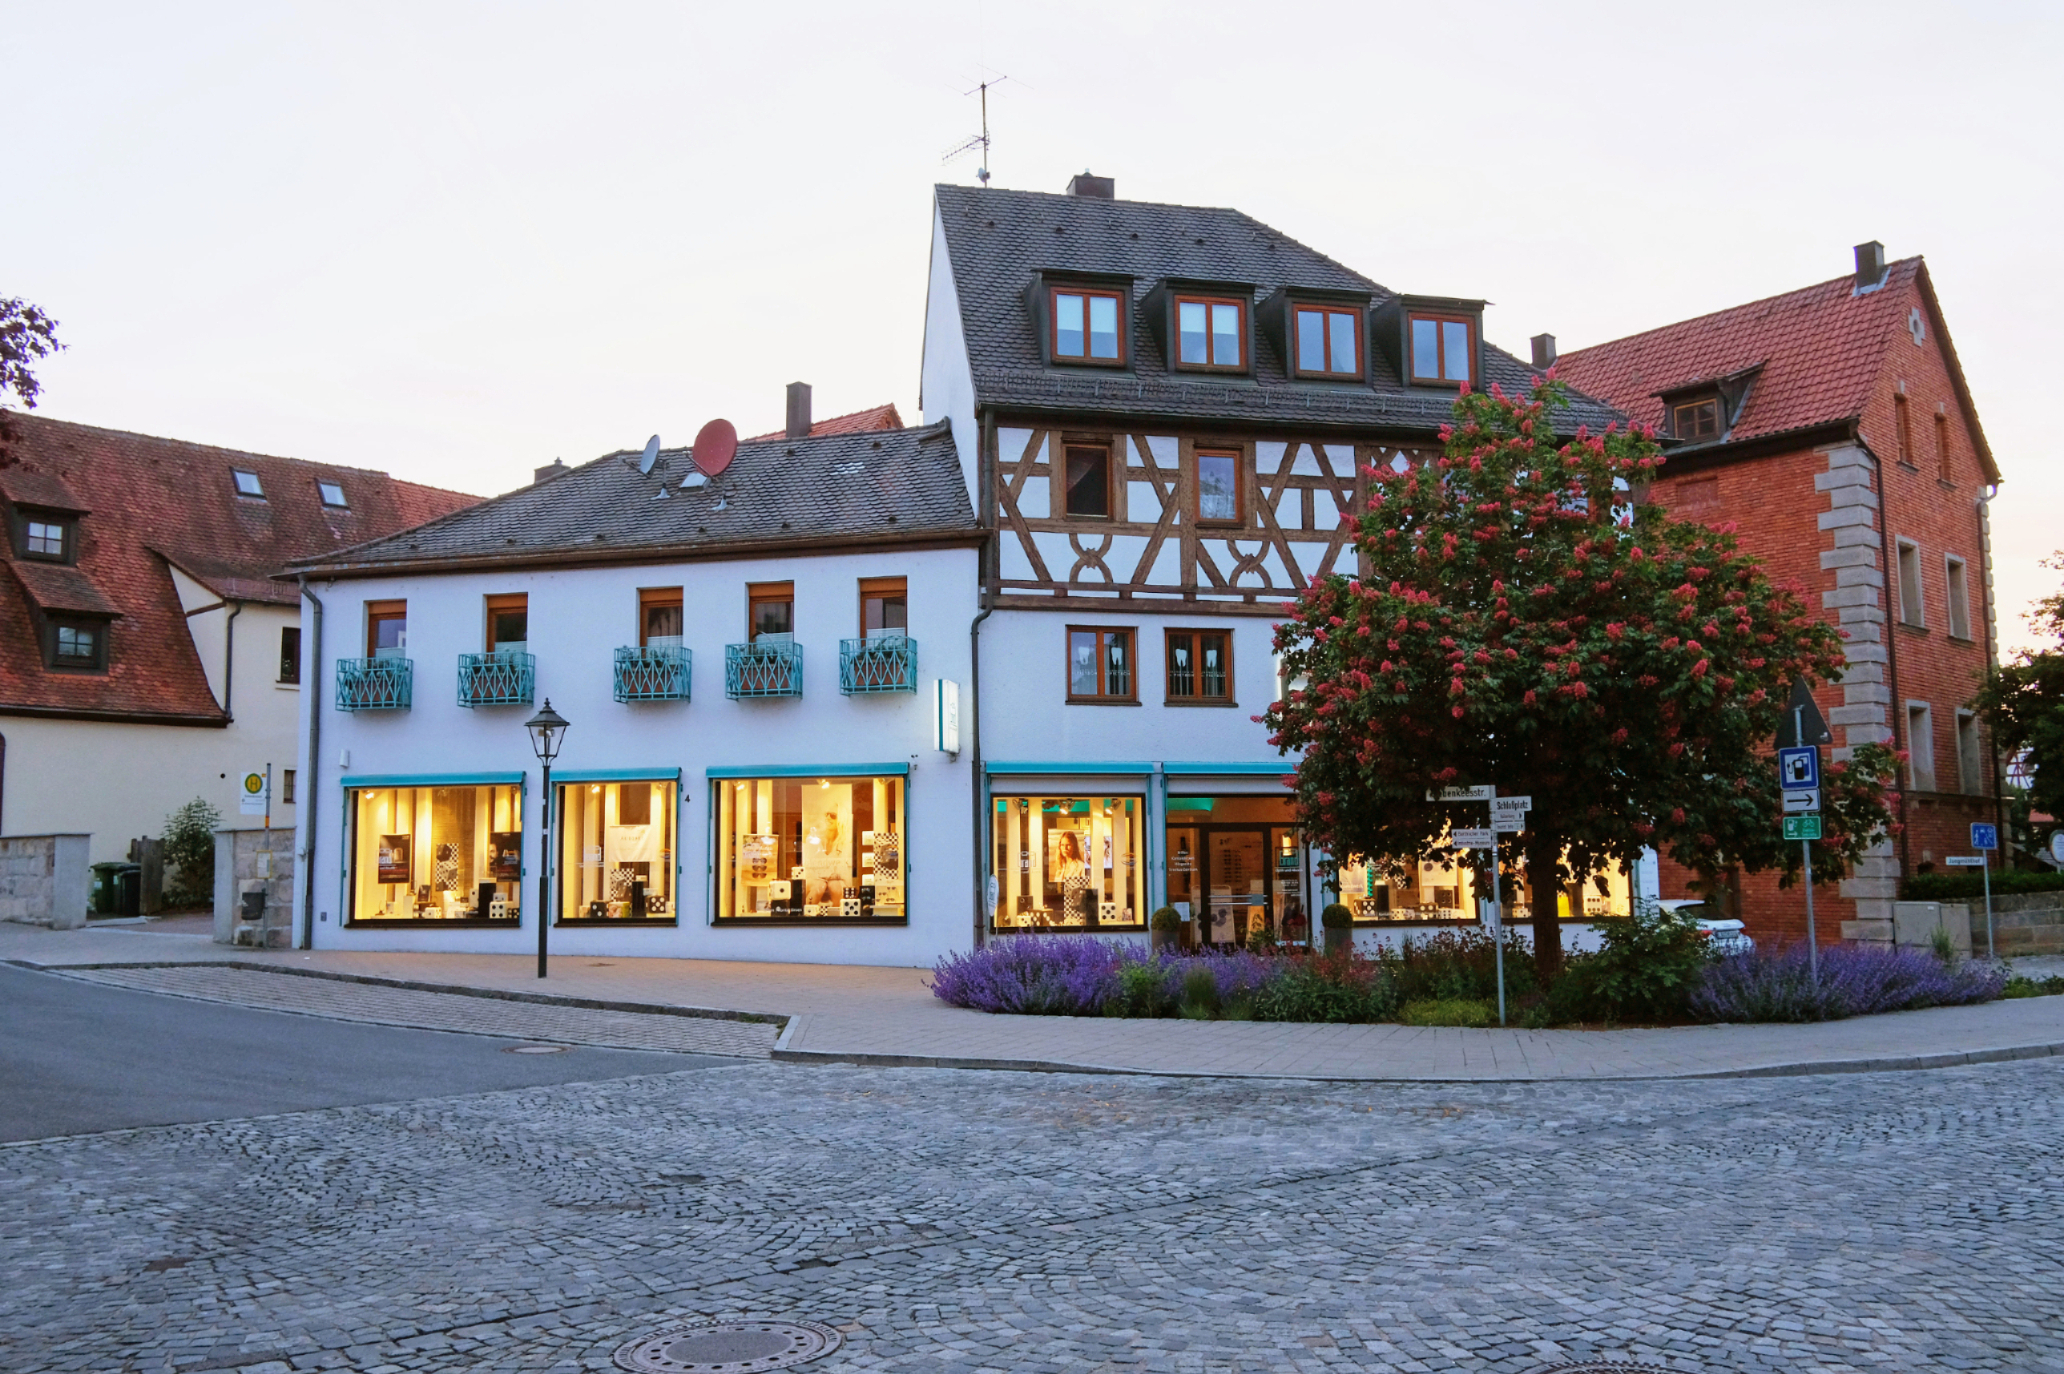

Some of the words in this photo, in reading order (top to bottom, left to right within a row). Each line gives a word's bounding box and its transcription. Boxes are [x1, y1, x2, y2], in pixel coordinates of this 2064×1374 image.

[250, 778, 258, 789] H
[684, 794, 691, 802] 4
[1496, 800, 1529, 811] Schloßplatz
